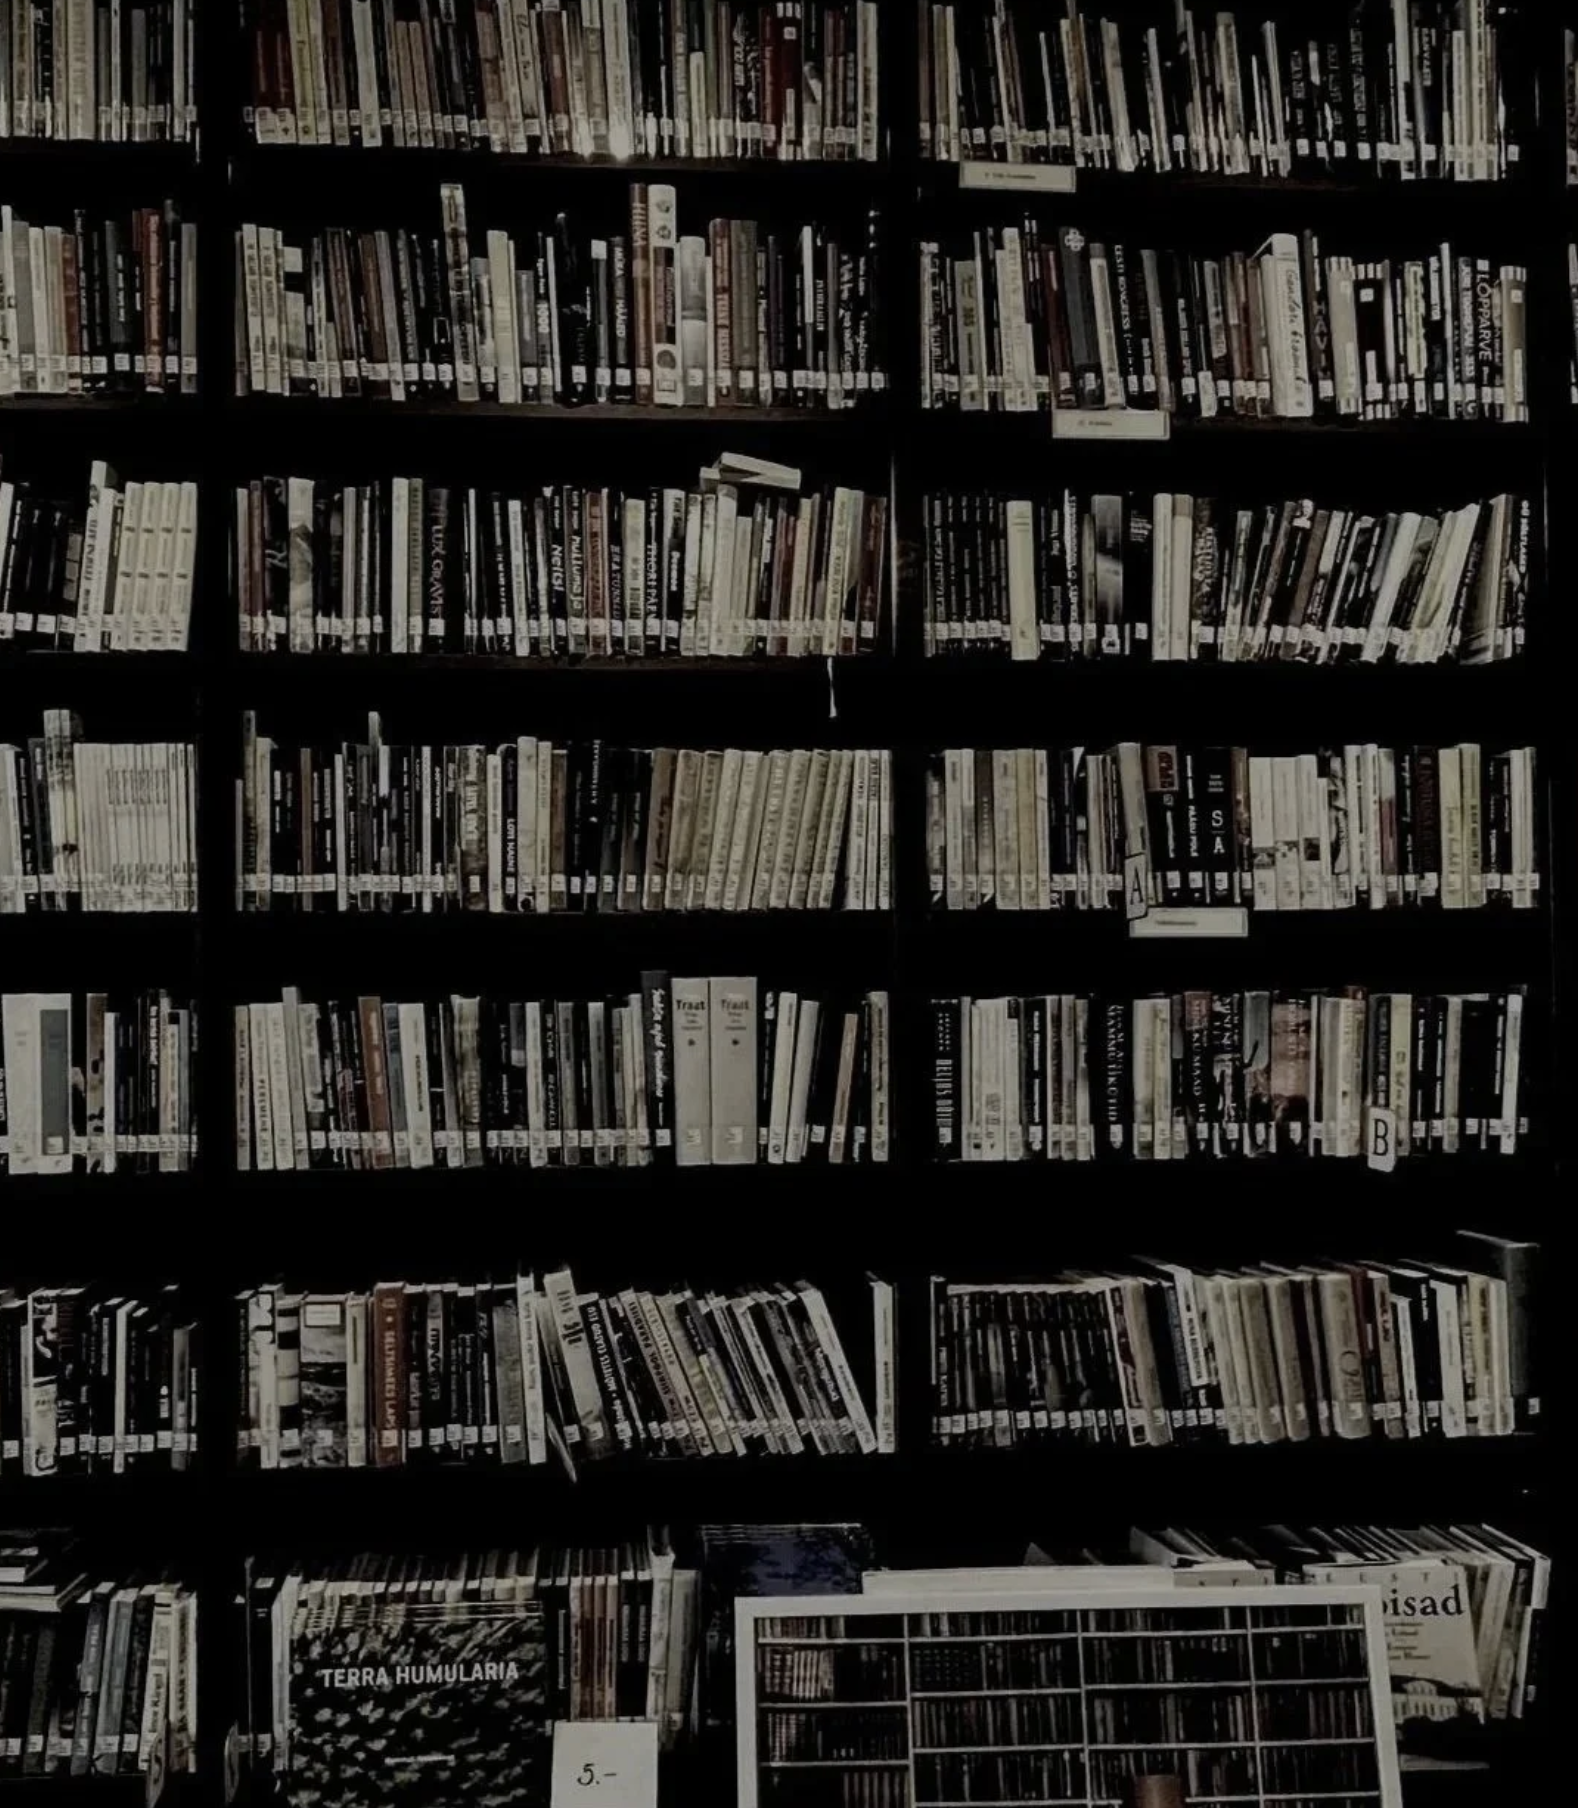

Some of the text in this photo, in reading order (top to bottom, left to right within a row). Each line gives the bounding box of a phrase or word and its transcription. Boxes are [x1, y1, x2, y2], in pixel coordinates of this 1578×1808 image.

[1477, 273, 1493, 361] LÕPPARVE
[1130, 866, 1144, 905] A
[676, 999, 706, 1011] Traat
[721, 999, 749, 1011] Traat
[1373, 1119, 1389, 1156] B
[385, 1330, 397, 1397] SELTSIMEES
[322, 1661, 520, 1688] TERRA HUMULARIA
